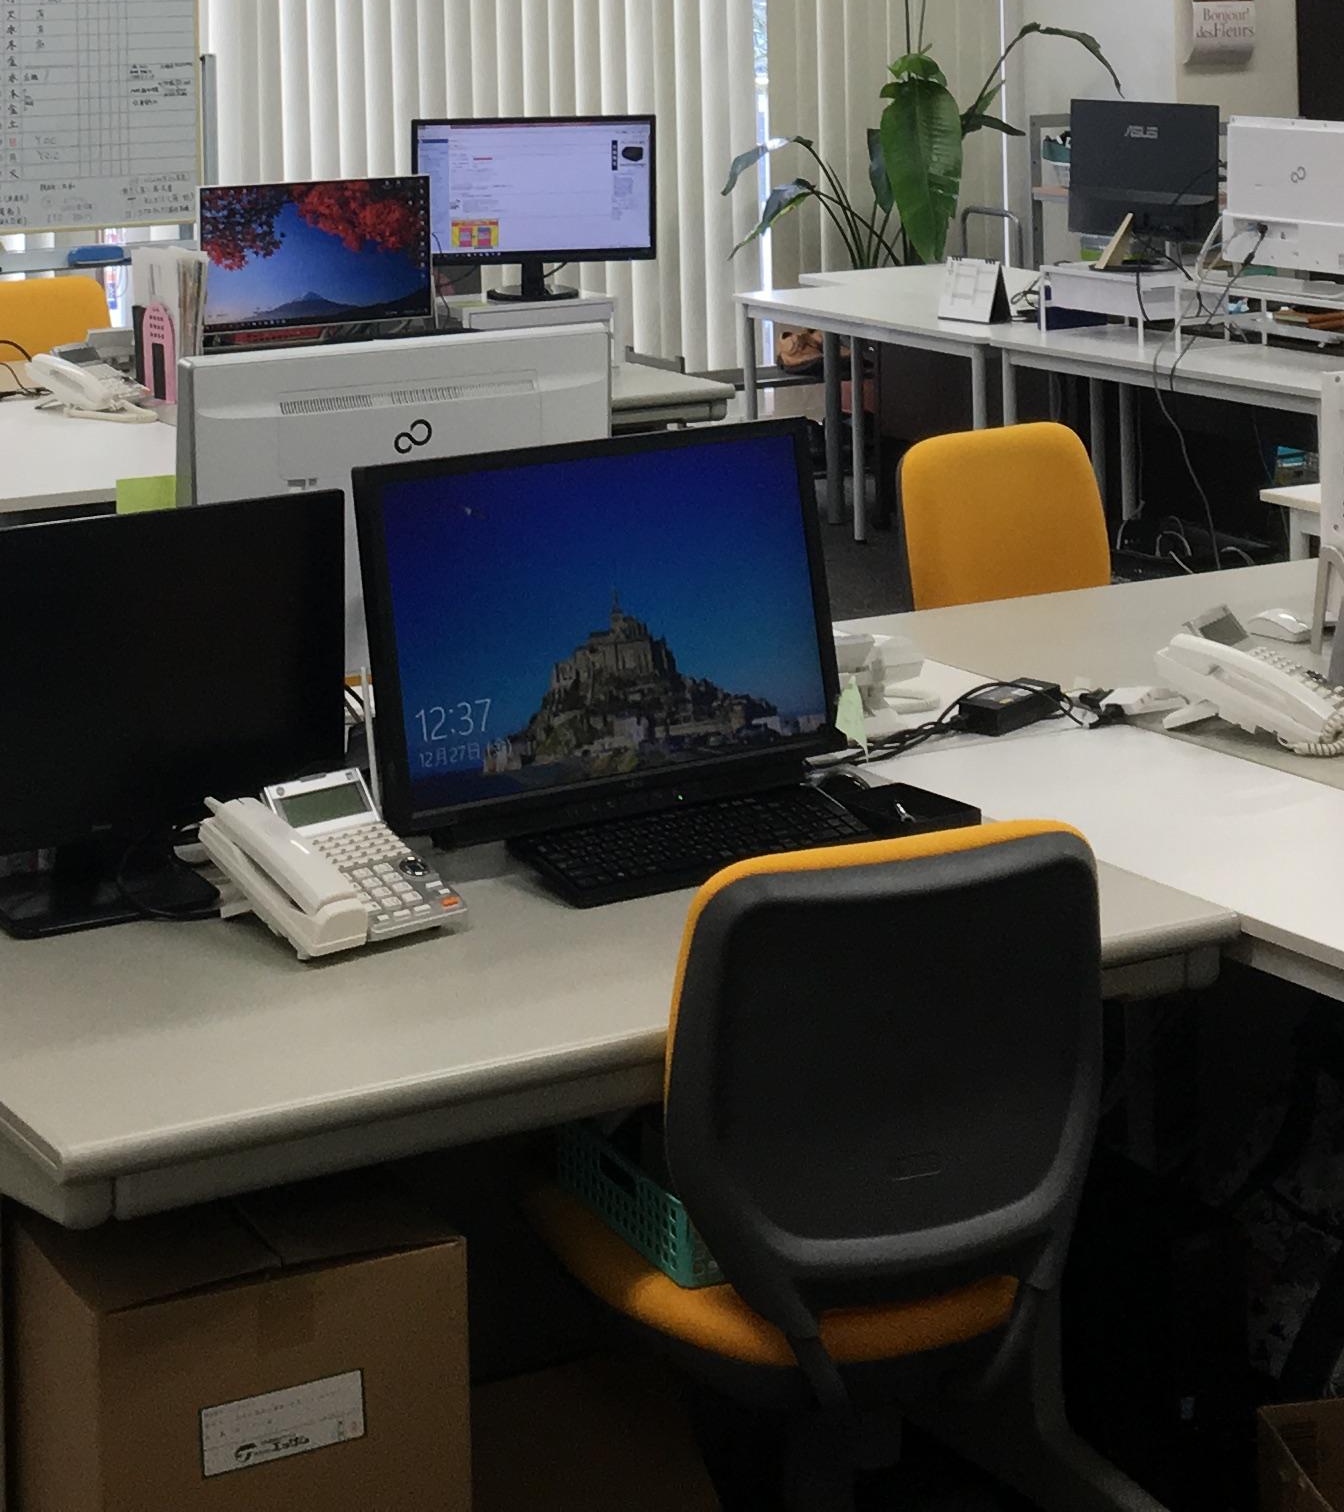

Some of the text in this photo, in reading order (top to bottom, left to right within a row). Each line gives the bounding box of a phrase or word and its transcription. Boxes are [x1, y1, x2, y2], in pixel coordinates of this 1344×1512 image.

[1124, 125, 1158, 139] ASUS
[415, 698, 491, 742] 12:37
[419, 742, 481, 768] 12月27日
